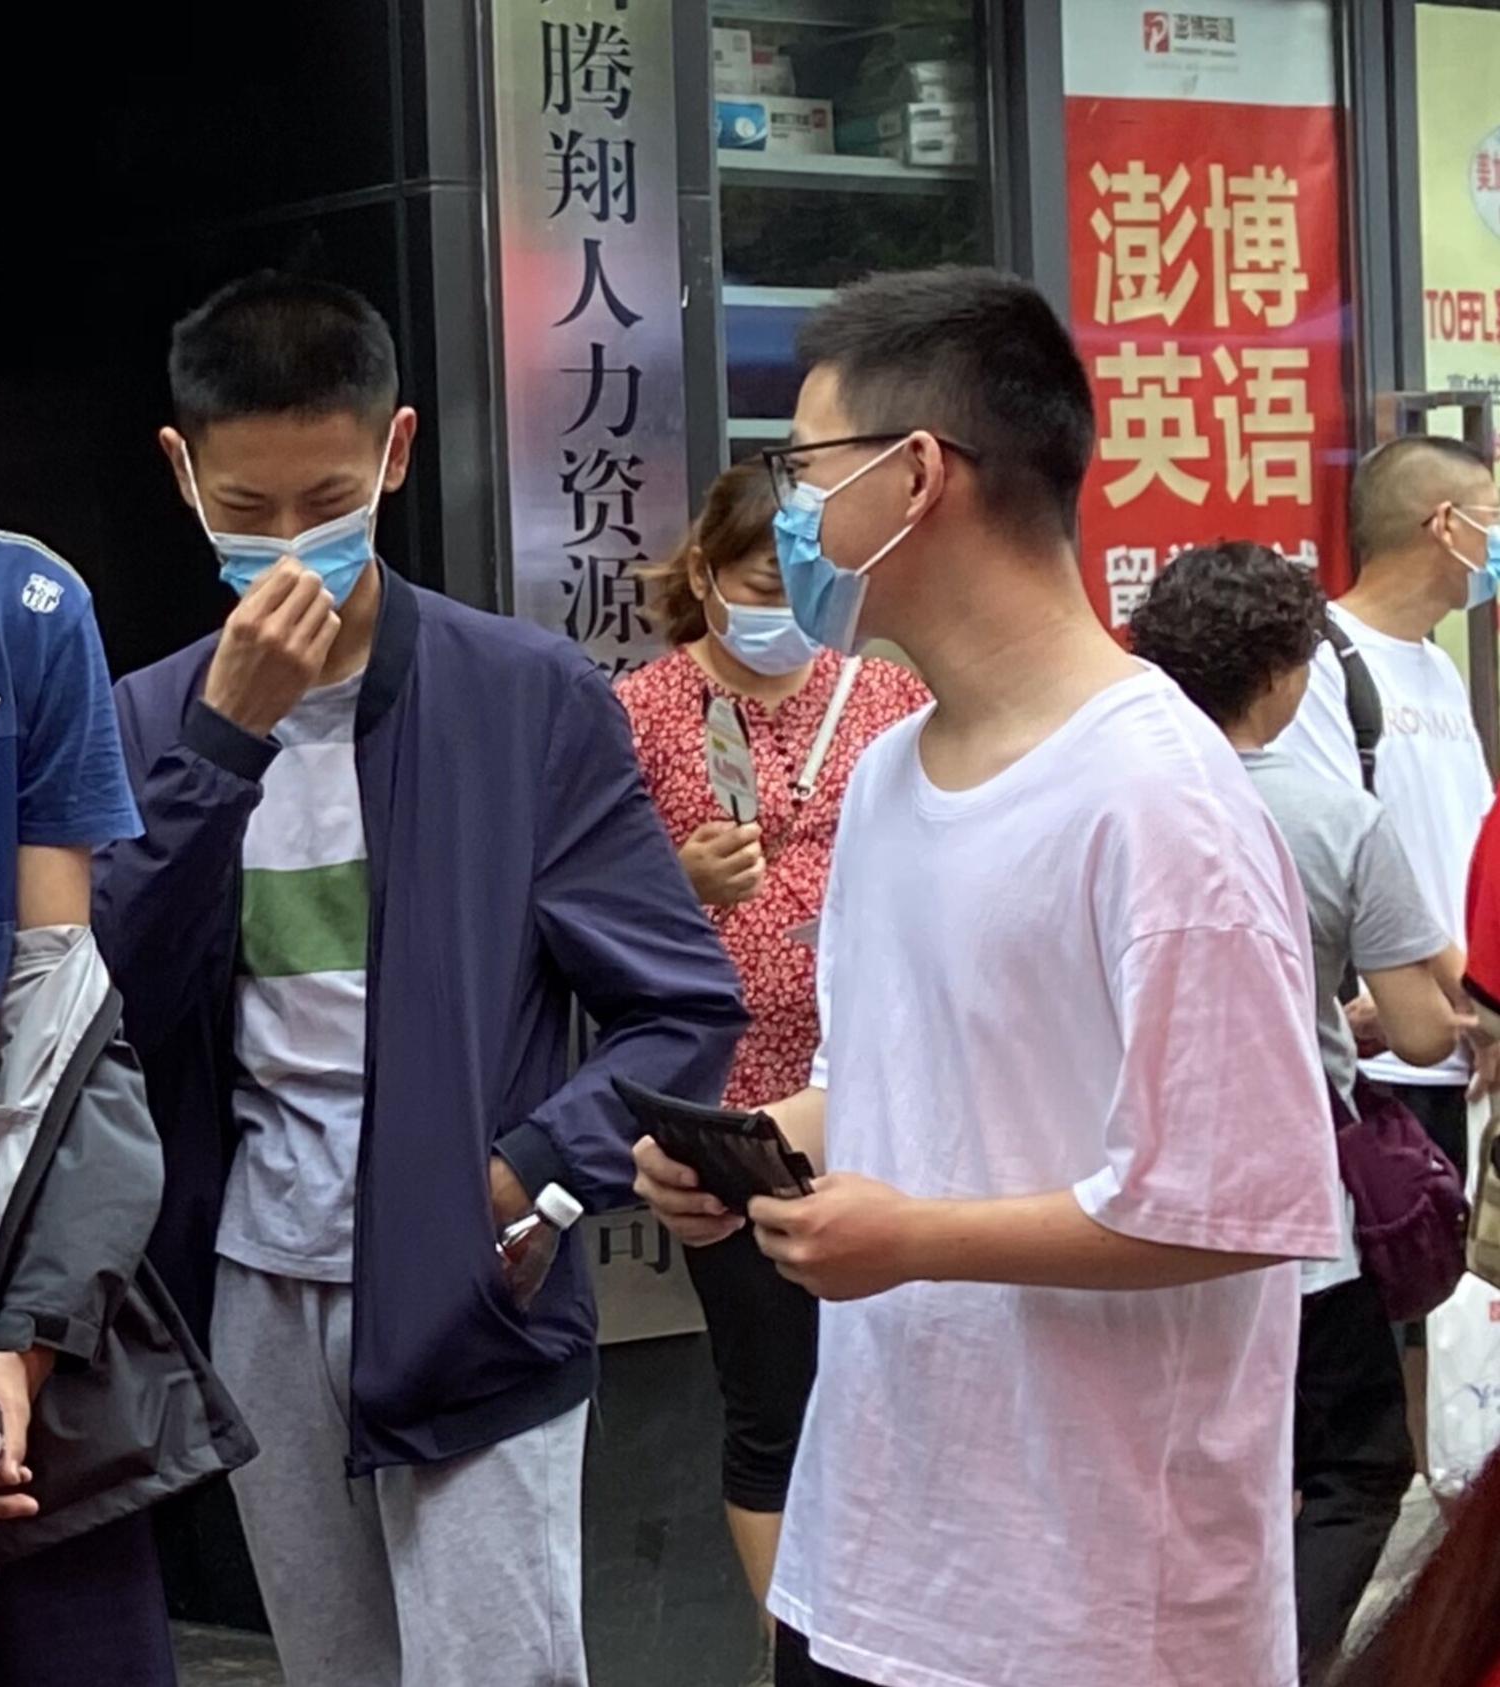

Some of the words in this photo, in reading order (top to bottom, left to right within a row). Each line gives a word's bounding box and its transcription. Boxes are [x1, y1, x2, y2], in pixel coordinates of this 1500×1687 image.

[1088, 159, 1309, 328] 澎博
[541, 0, 650, 686] 腾翔人力资源
[1094, 341, 1315, 508] 英语
